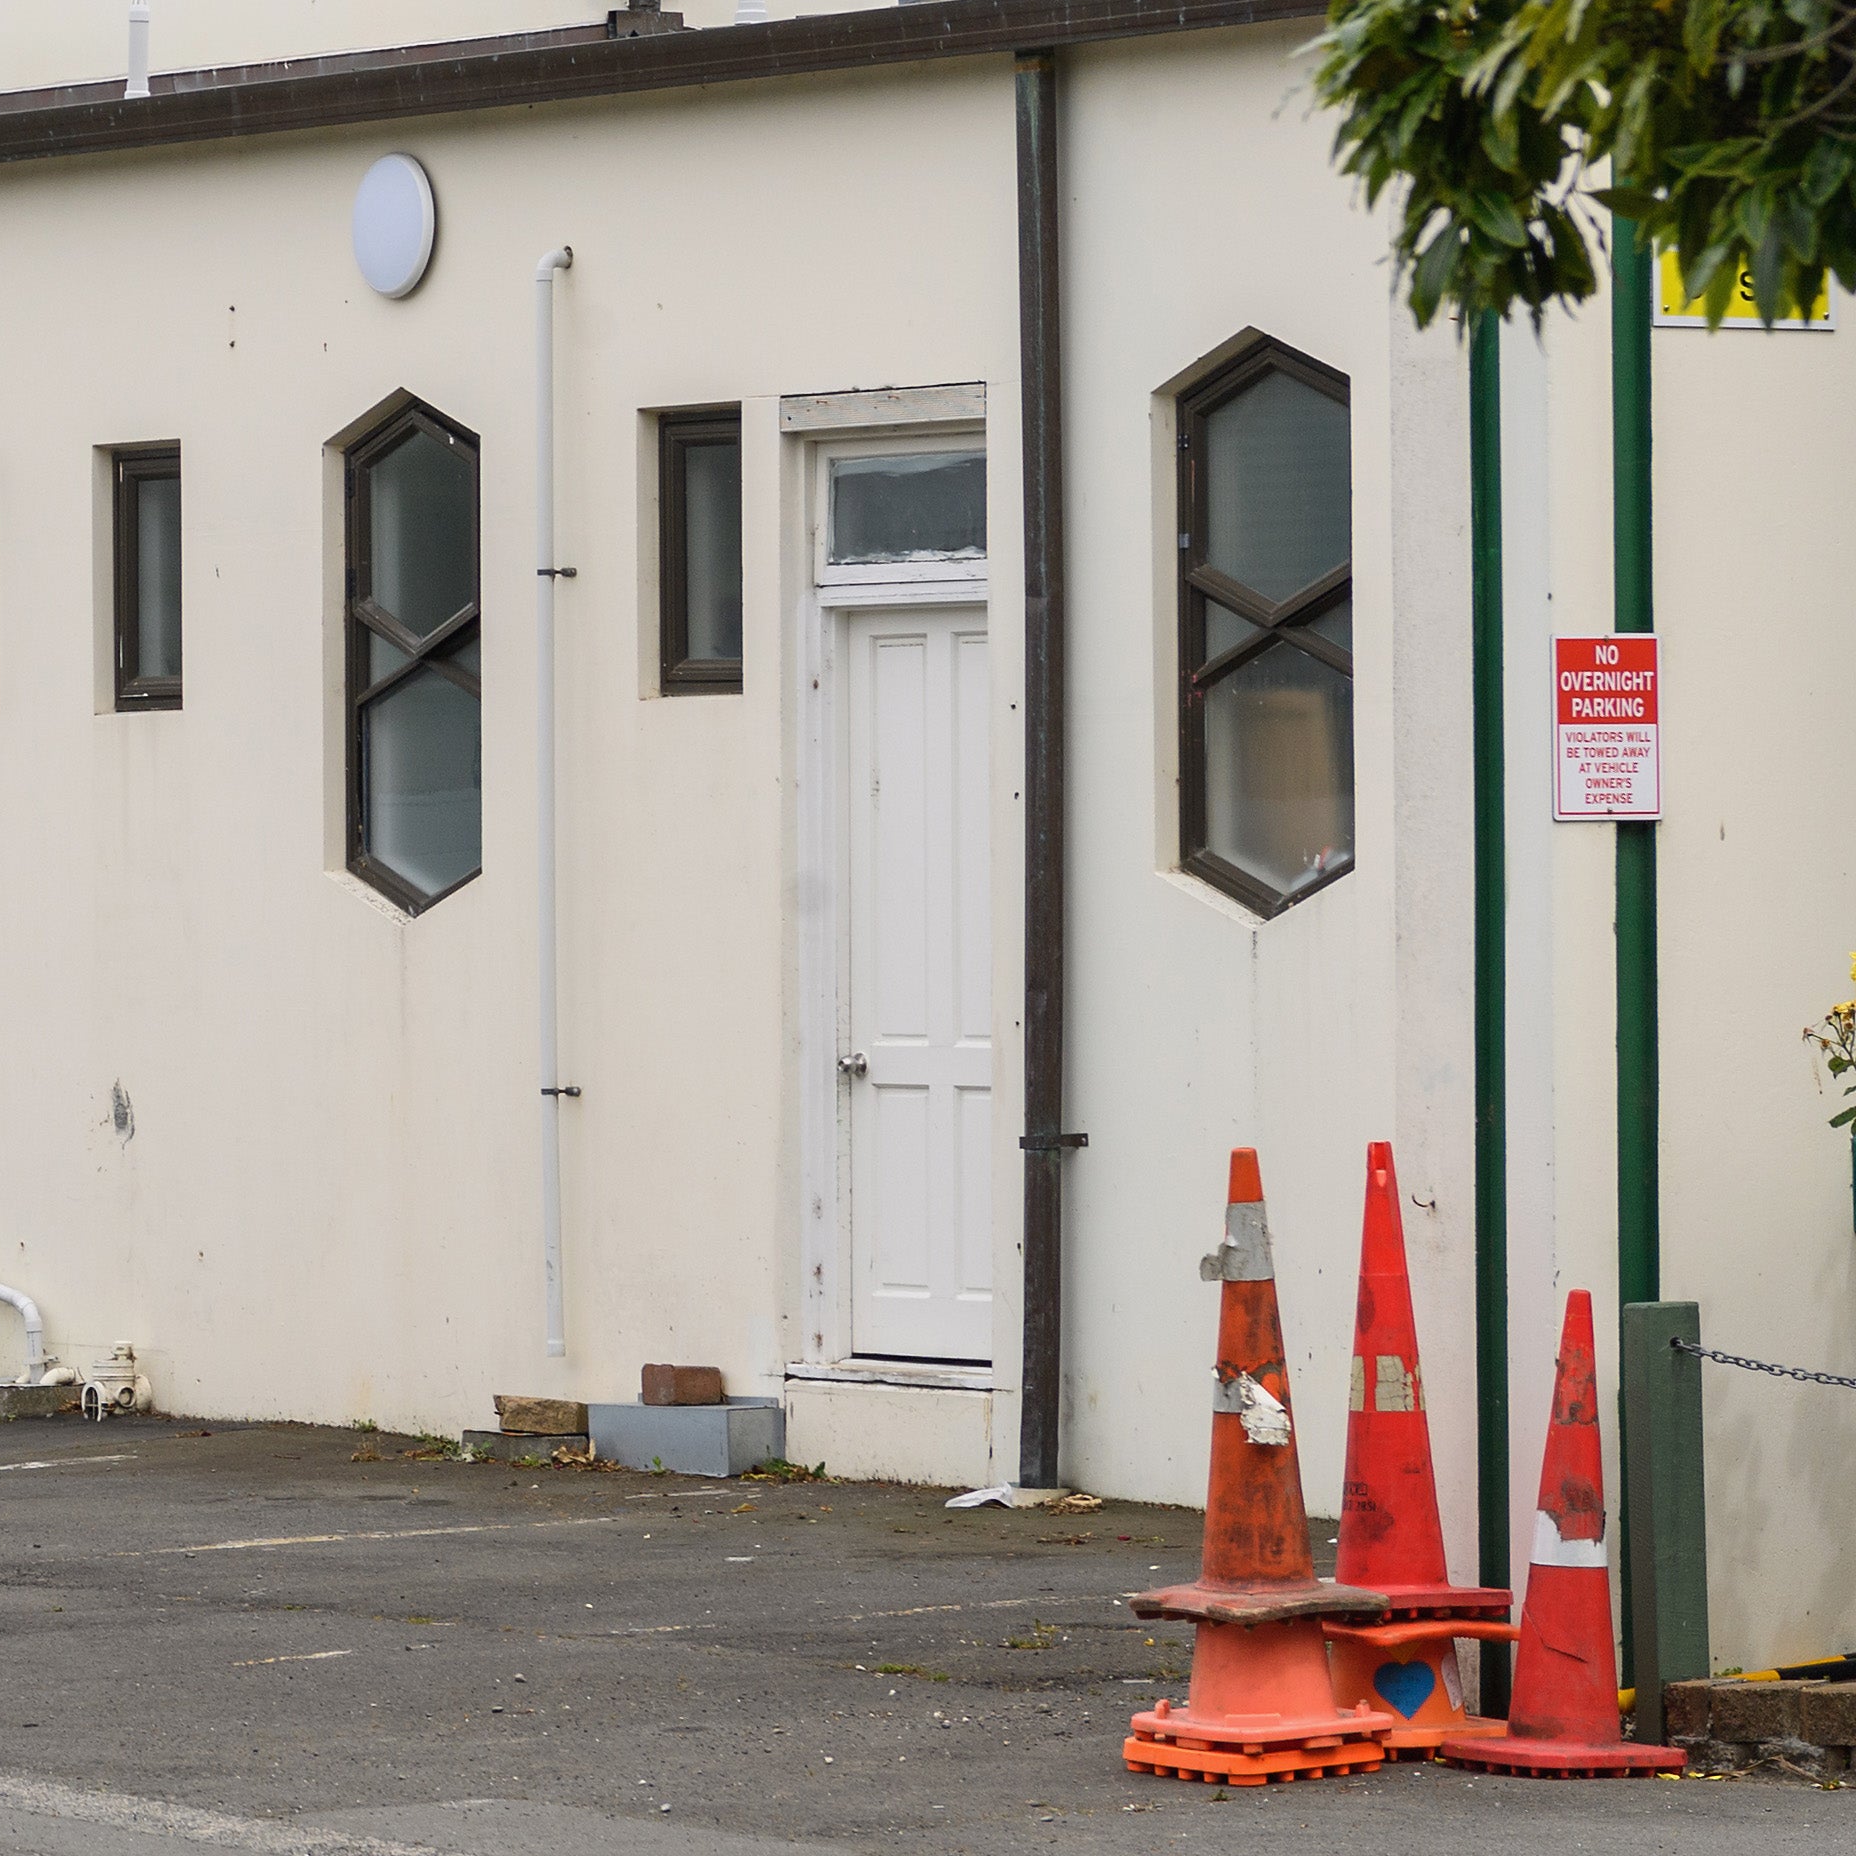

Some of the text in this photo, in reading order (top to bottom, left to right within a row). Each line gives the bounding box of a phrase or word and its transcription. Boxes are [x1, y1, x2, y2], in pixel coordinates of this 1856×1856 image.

[1595, 645, 1619, 665] NO
[1561, 671, 1654, 691] OVERNIGHT
[1572, 698, 1644, 717] PARKING
[1565, 732, 1651, 743] VIOLATORS WILL
[1567, 747, 1650, 758] BE TOWED AWAY
[1579, 762, 1639, 774] AT VEHICLE
[1585, 778, 1632, 789] OWNER'S
[1585, 793, 1633, 804] EXPENSE
